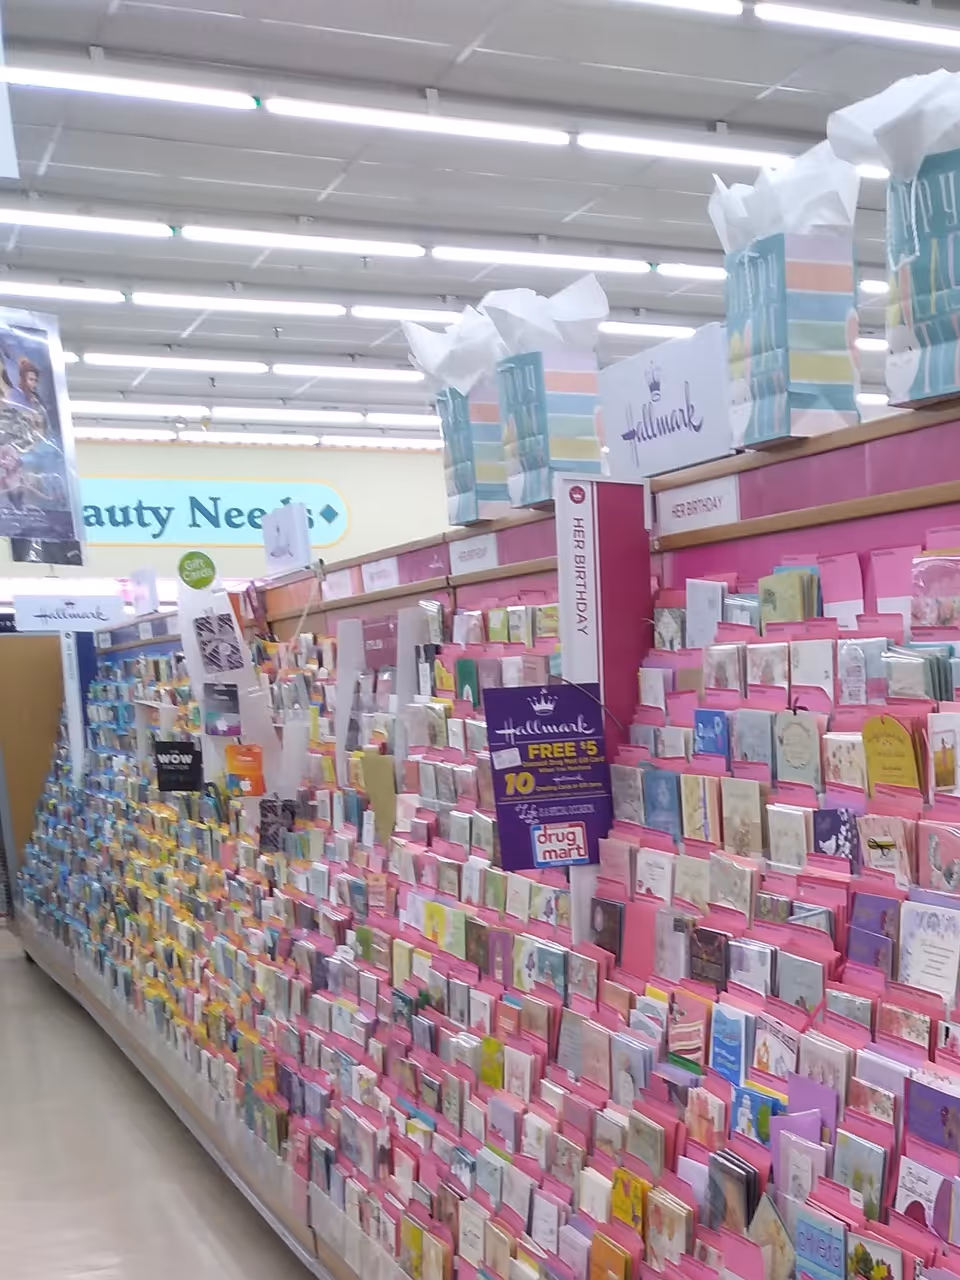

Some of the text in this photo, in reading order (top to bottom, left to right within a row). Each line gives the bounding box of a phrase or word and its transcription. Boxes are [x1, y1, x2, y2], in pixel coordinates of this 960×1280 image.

[622, 381, 704, 468] Hallmark
[83, 496, 315, 539] auty Nees
[671, 495, 724, 519] HER BIRTHDAY
[182, 567, 214, 582] Cards
[184, 558, 205, 571] Gift
[572, 517, 589, 636] HER BIRTHDAY
[33, 605, 110, 627] Hallmark
[495, 714, 596, 745] Hallmark
[157, 753, 193, 764] WOW
[528, 740, 598, 759] FREE $5
[504, 771, 535, 796] 10
[537, 825, 576, 846] drug
[543, 844, 586, 860] mart
